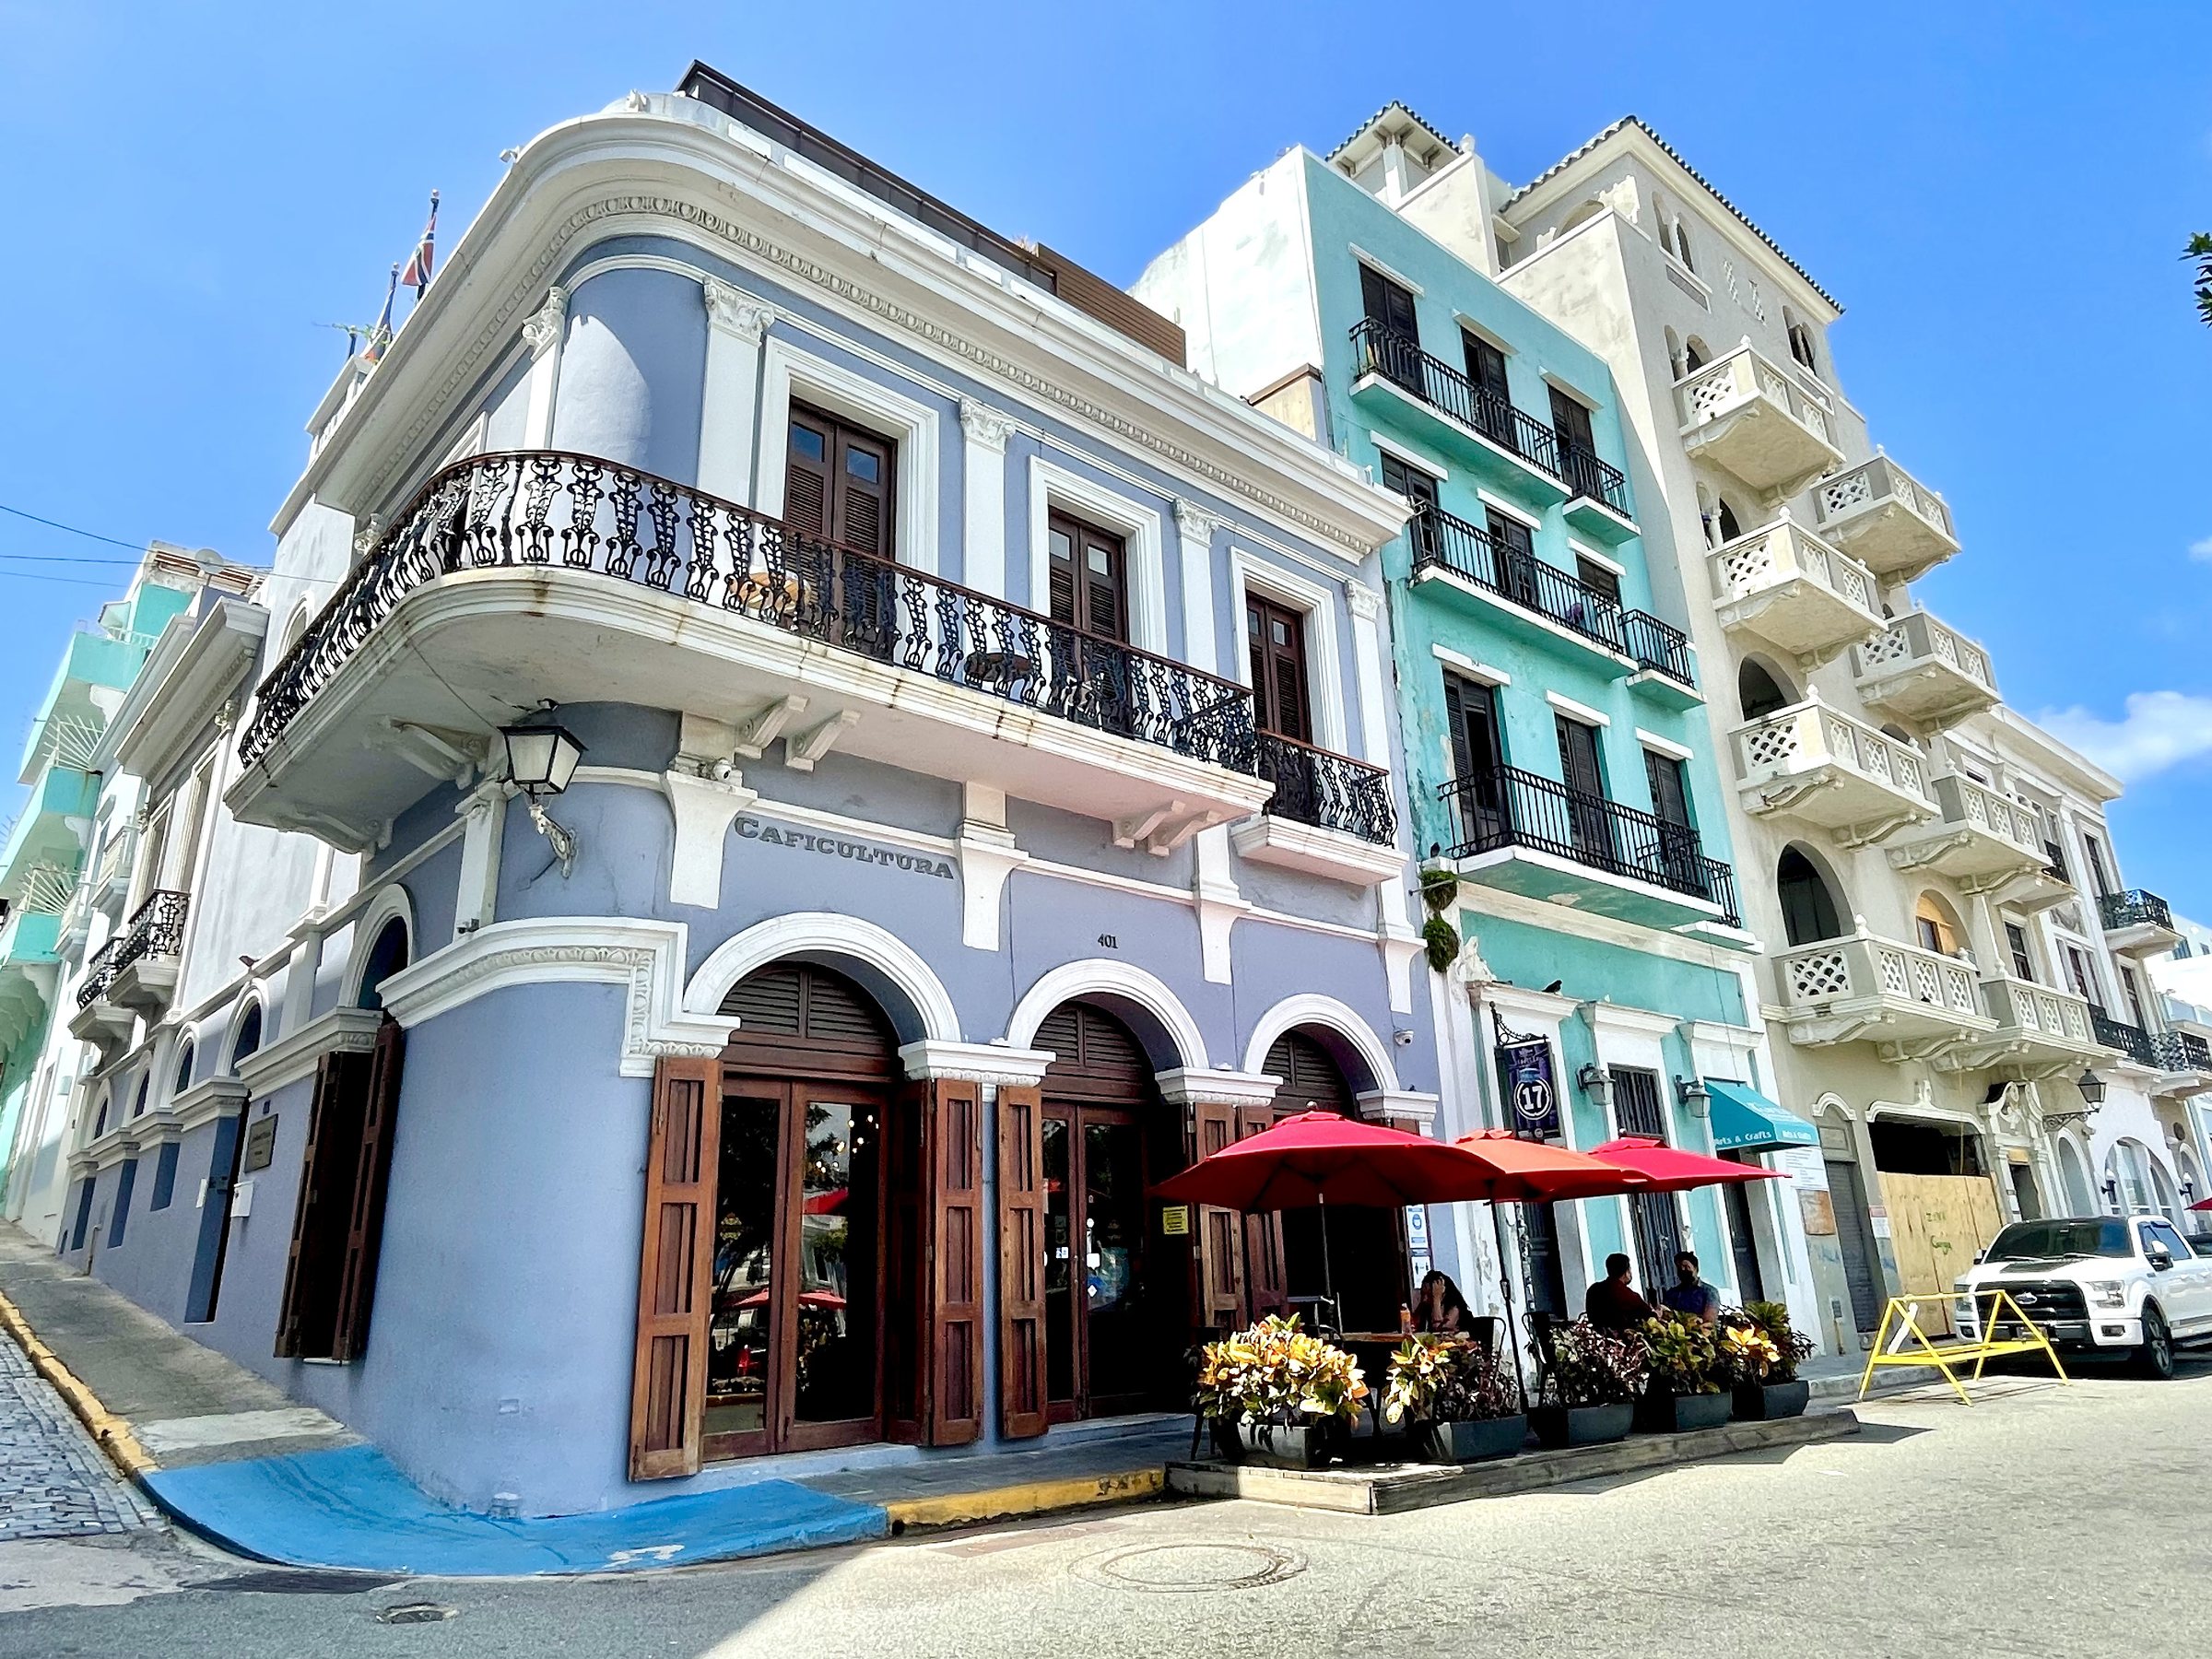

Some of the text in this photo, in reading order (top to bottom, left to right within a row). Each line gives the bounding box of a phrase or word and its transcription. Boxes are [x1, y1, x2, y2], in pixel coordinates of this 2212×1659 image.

[734, 817, 954, 879] CAFICULTURA
[1098, 934, 1118, 948] 401
[1522, 1085, 1543, 1111] 17
[1745, 1130, 1771, 1141] Crafts
